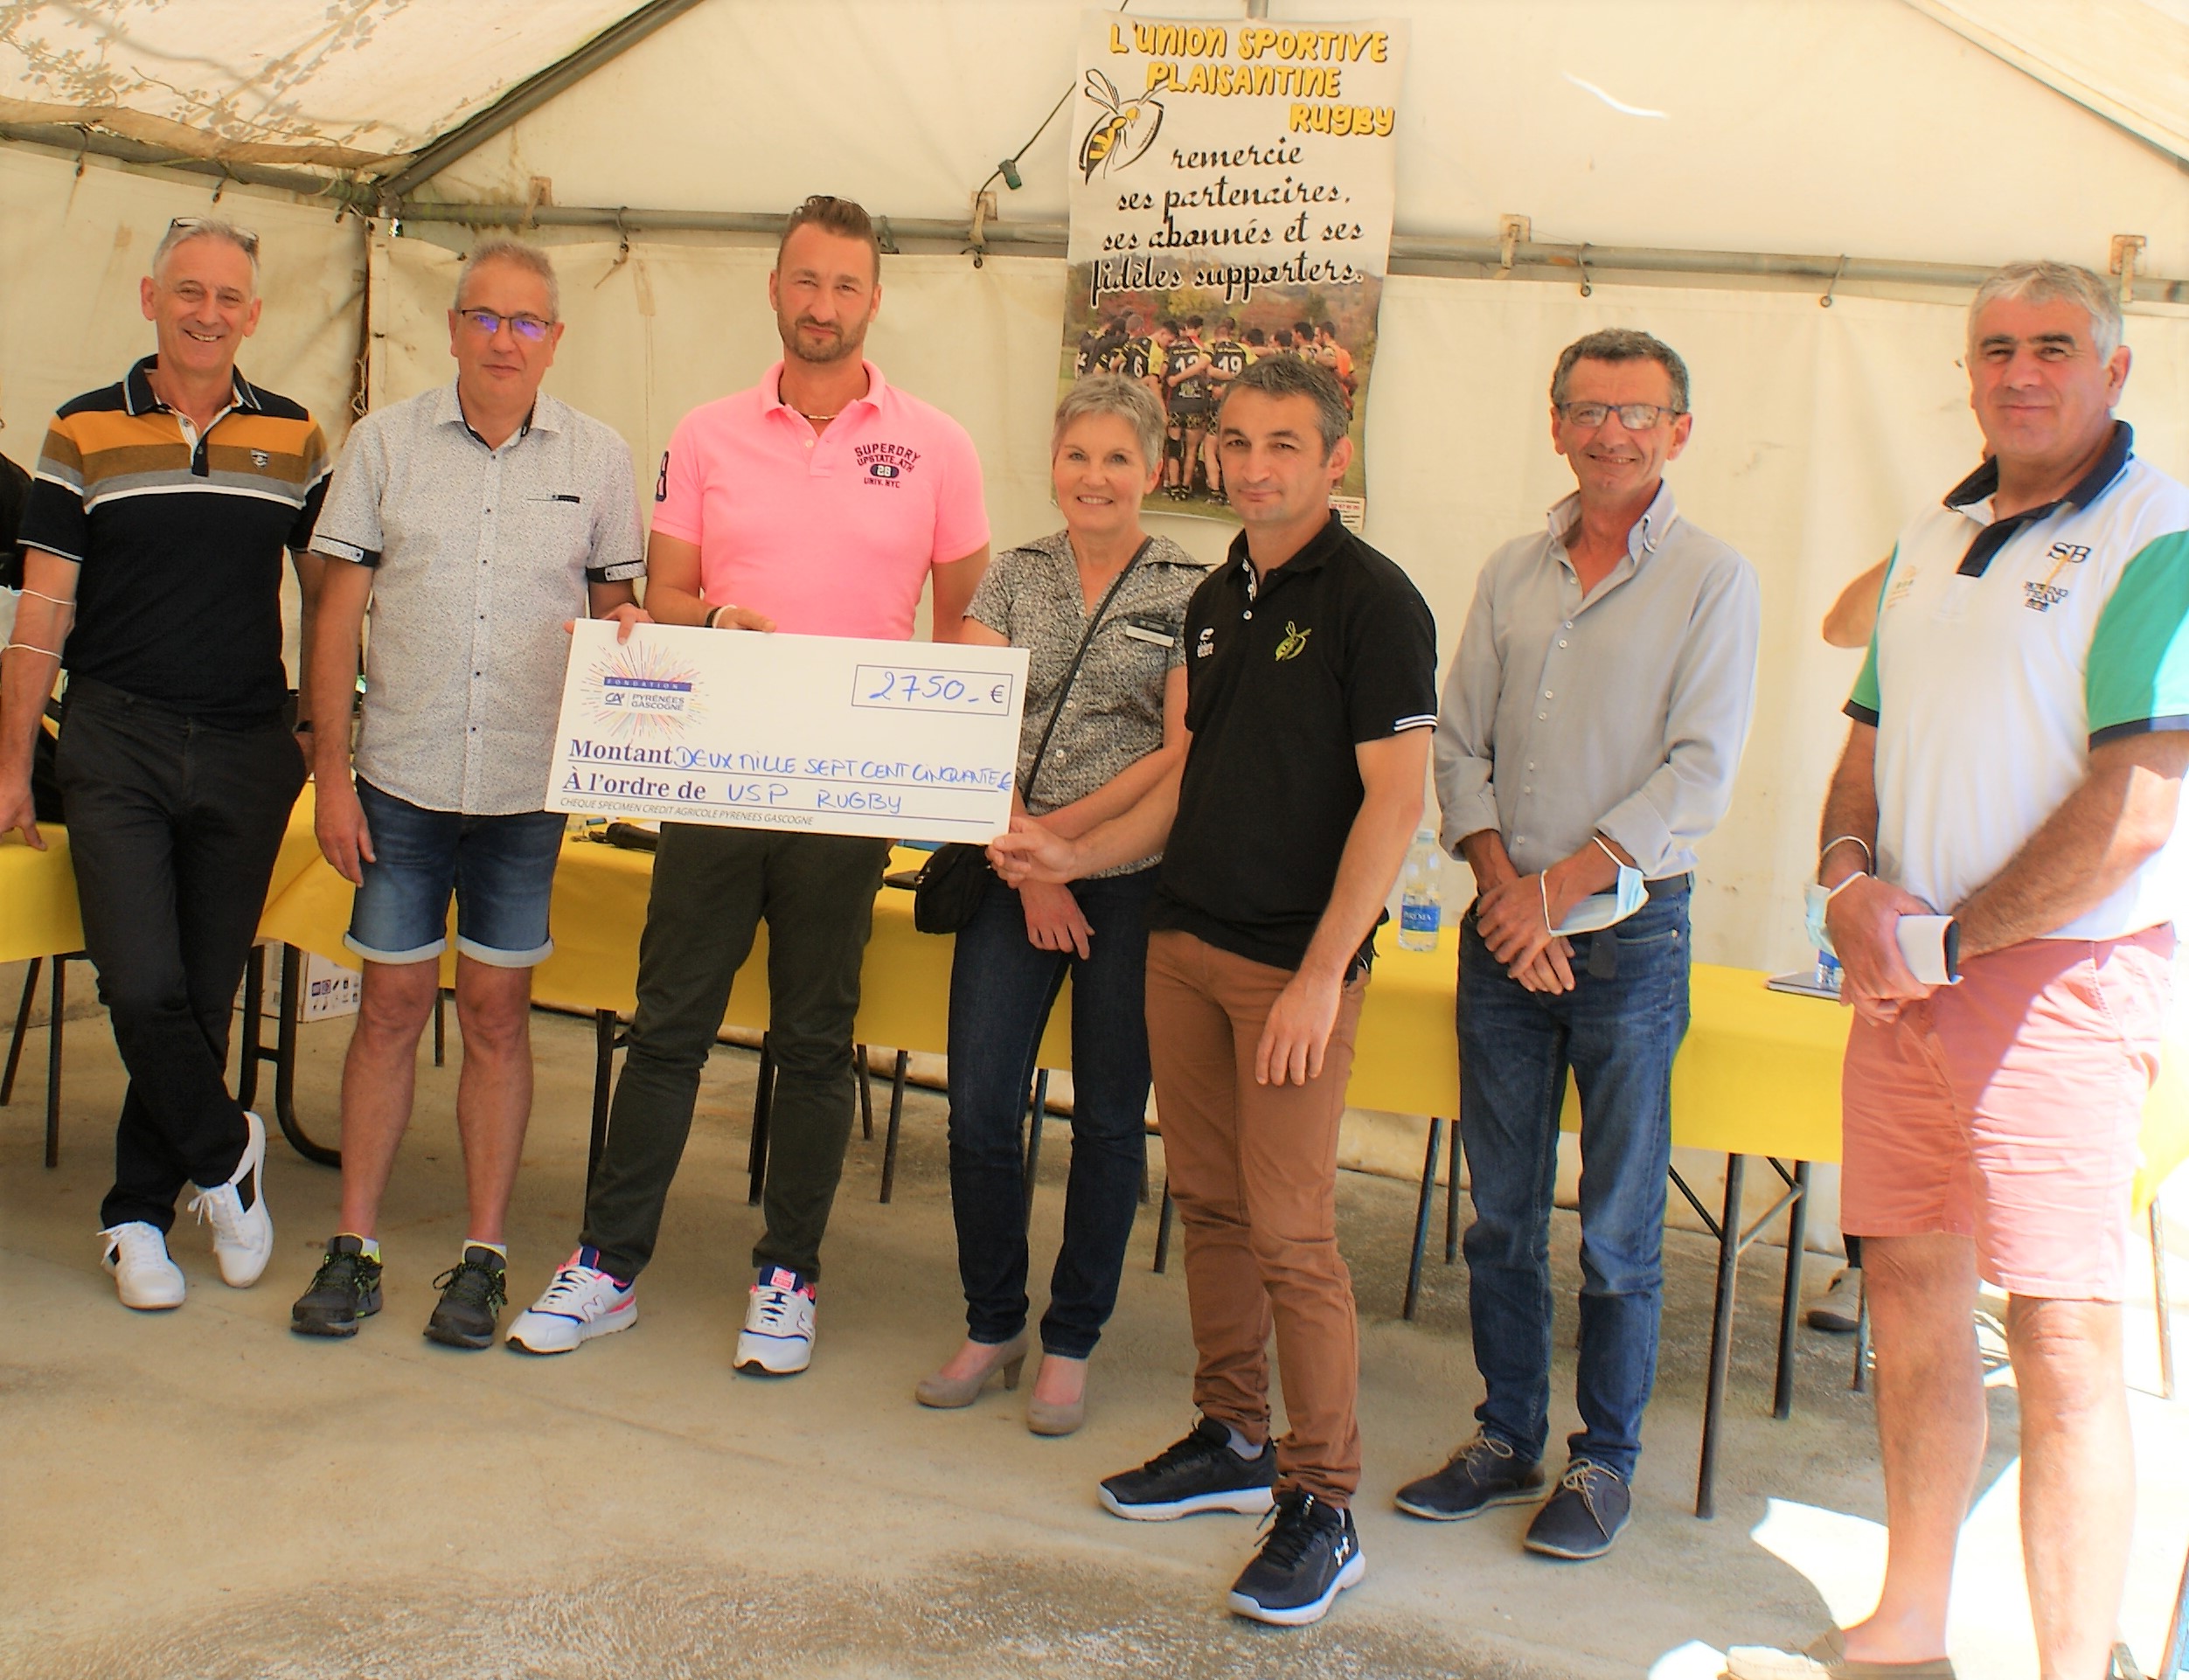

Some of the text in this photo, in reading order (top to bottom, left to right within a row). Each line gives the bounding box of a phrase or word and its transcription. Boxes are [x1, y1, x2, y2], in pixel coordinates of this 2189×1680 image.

[1109, 22, 1388, 62] L'UNION SPORTIVE
[1147, 61, 1341, 98] PLAISANTINE
[1289, 102, 1395, 136] RUGBY
[1171, 136, 1304, 170] remercie
[1117, 191, 1155, 212] ses
[1102, 211, 1364, 252] ses abonnés et ses
[1090, 251, 1364, 309] fidèles supporters.
[854, 443, 921, 463] SUPERDRY
[606, 677, 679, 690] FONDATION
[631, 701, 684, 711] GASCOGNE
[569, 738, 673, 765] Montant
[674, 746, 733, 769] DEUX
[804, 758, 858, 776] SEPT
[861, 760, 909, 779] CENT
[562, 766, 582, 790] À
[678, 780, 707, 801] de
[560, 797, 814, 826] CHEQUE SPECIMEN CREDIT AGRICOLE PYRENEES GASCOGNE
